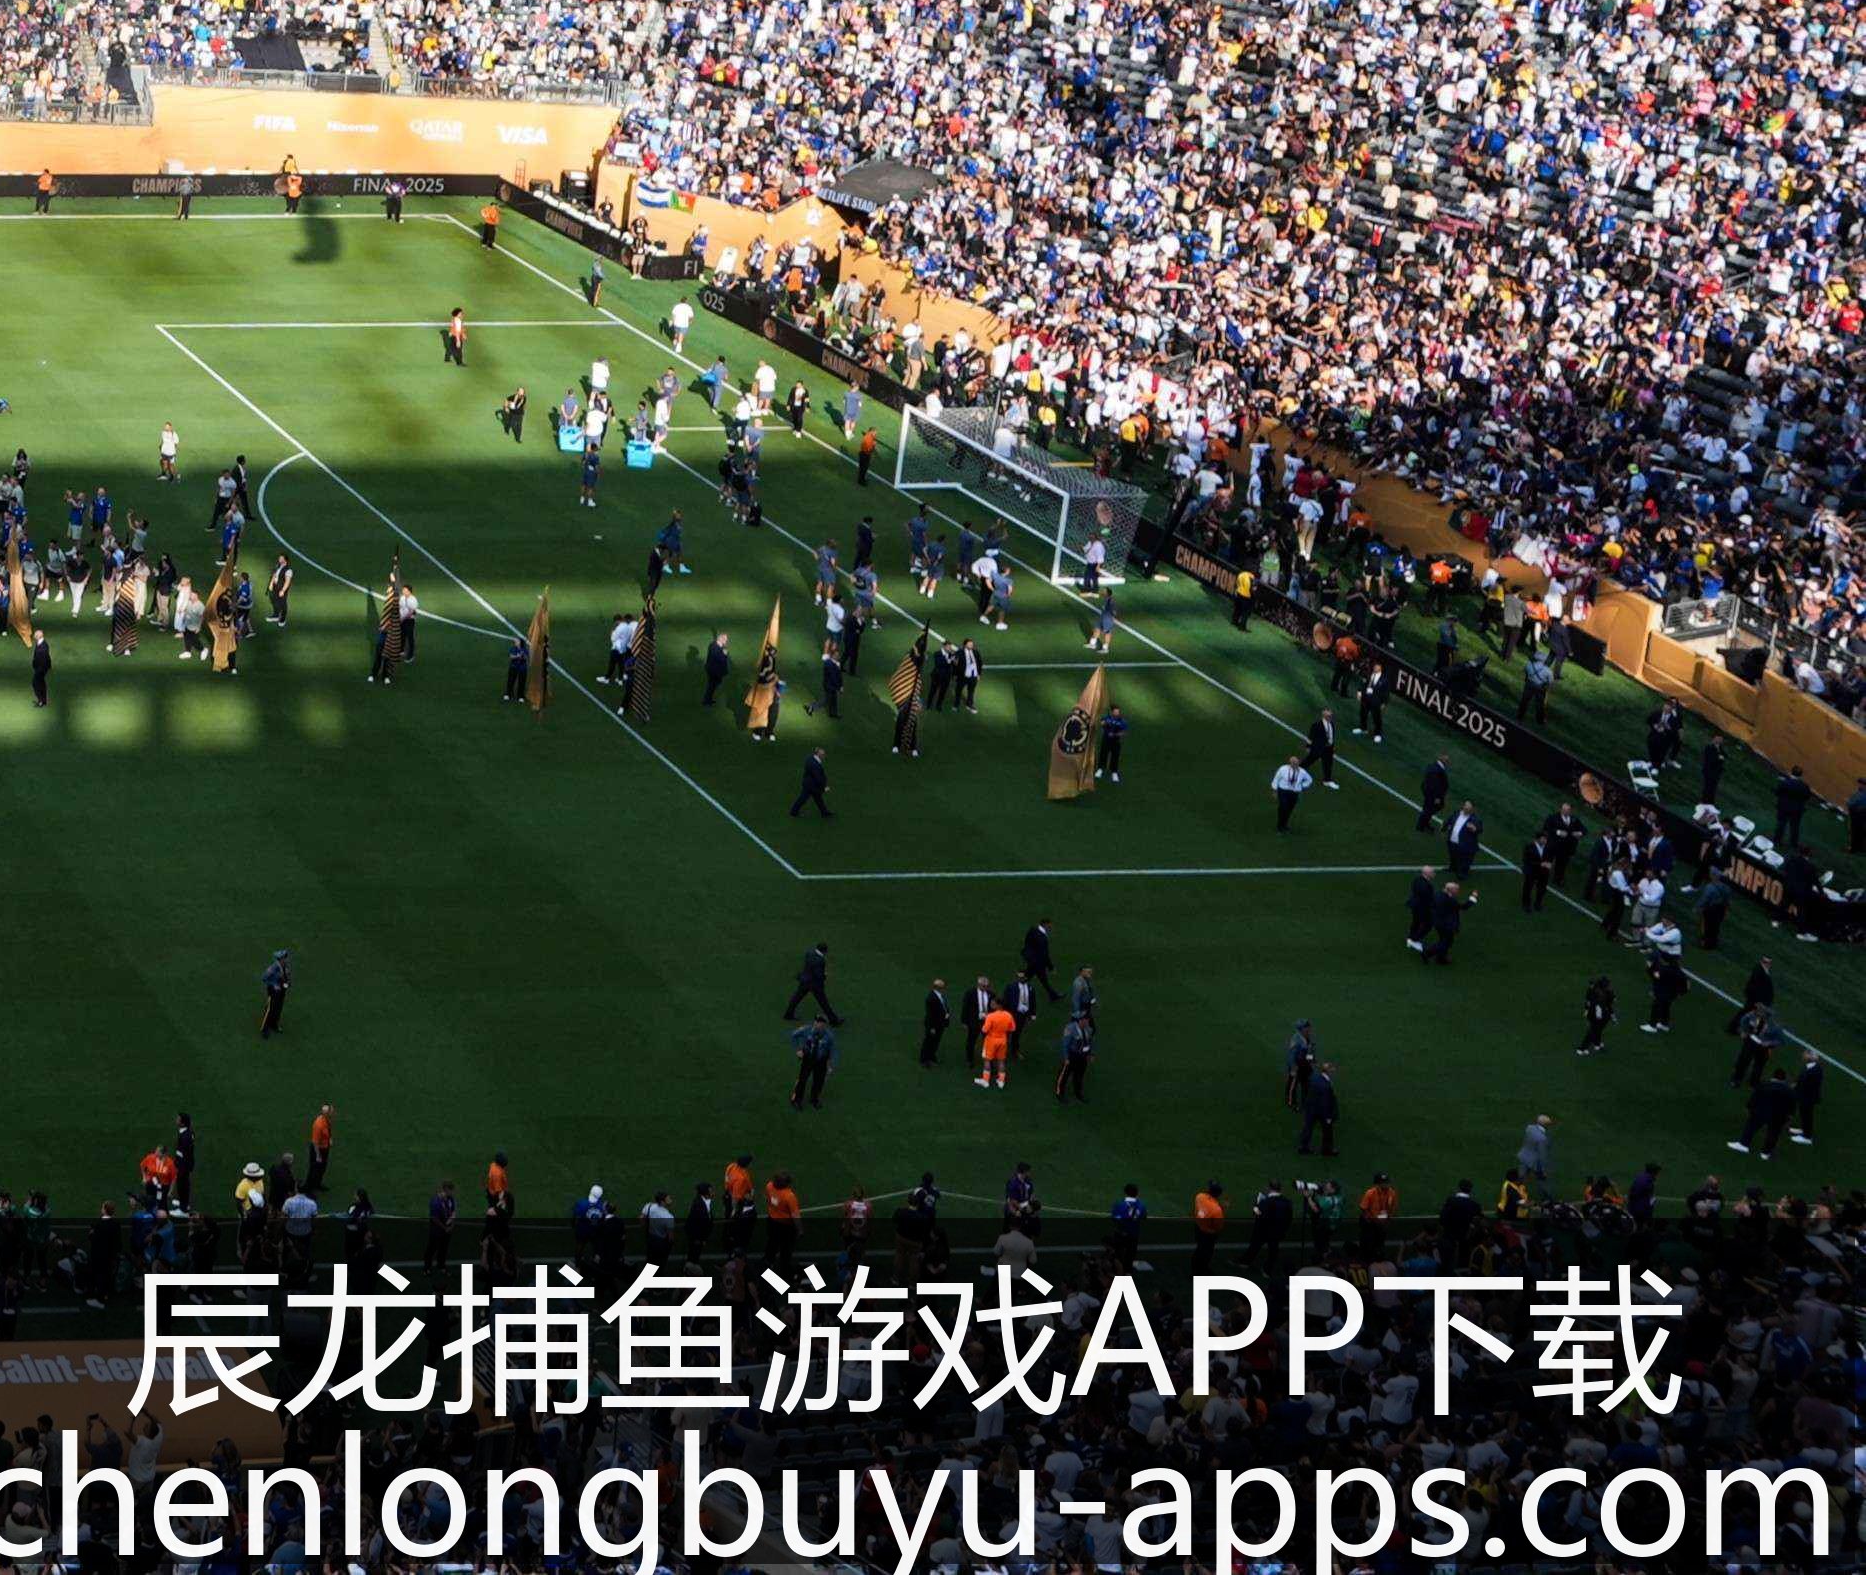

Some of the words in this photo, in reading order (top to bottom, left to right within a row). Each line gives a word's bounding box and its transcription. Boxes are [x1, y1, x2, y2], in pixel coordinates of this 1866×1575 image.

[252, 115, 297, 132] FIFA
[497, 125, 549, 144] VISA
[353, 178, 390, 194] FINA
[406, 178, 446, 195] 2025
[1175, 544, 1237, 595] CHAMPION
[1396, 669, 1454, 721] FINAL
[1457, 703, 1507, 748] 2025
